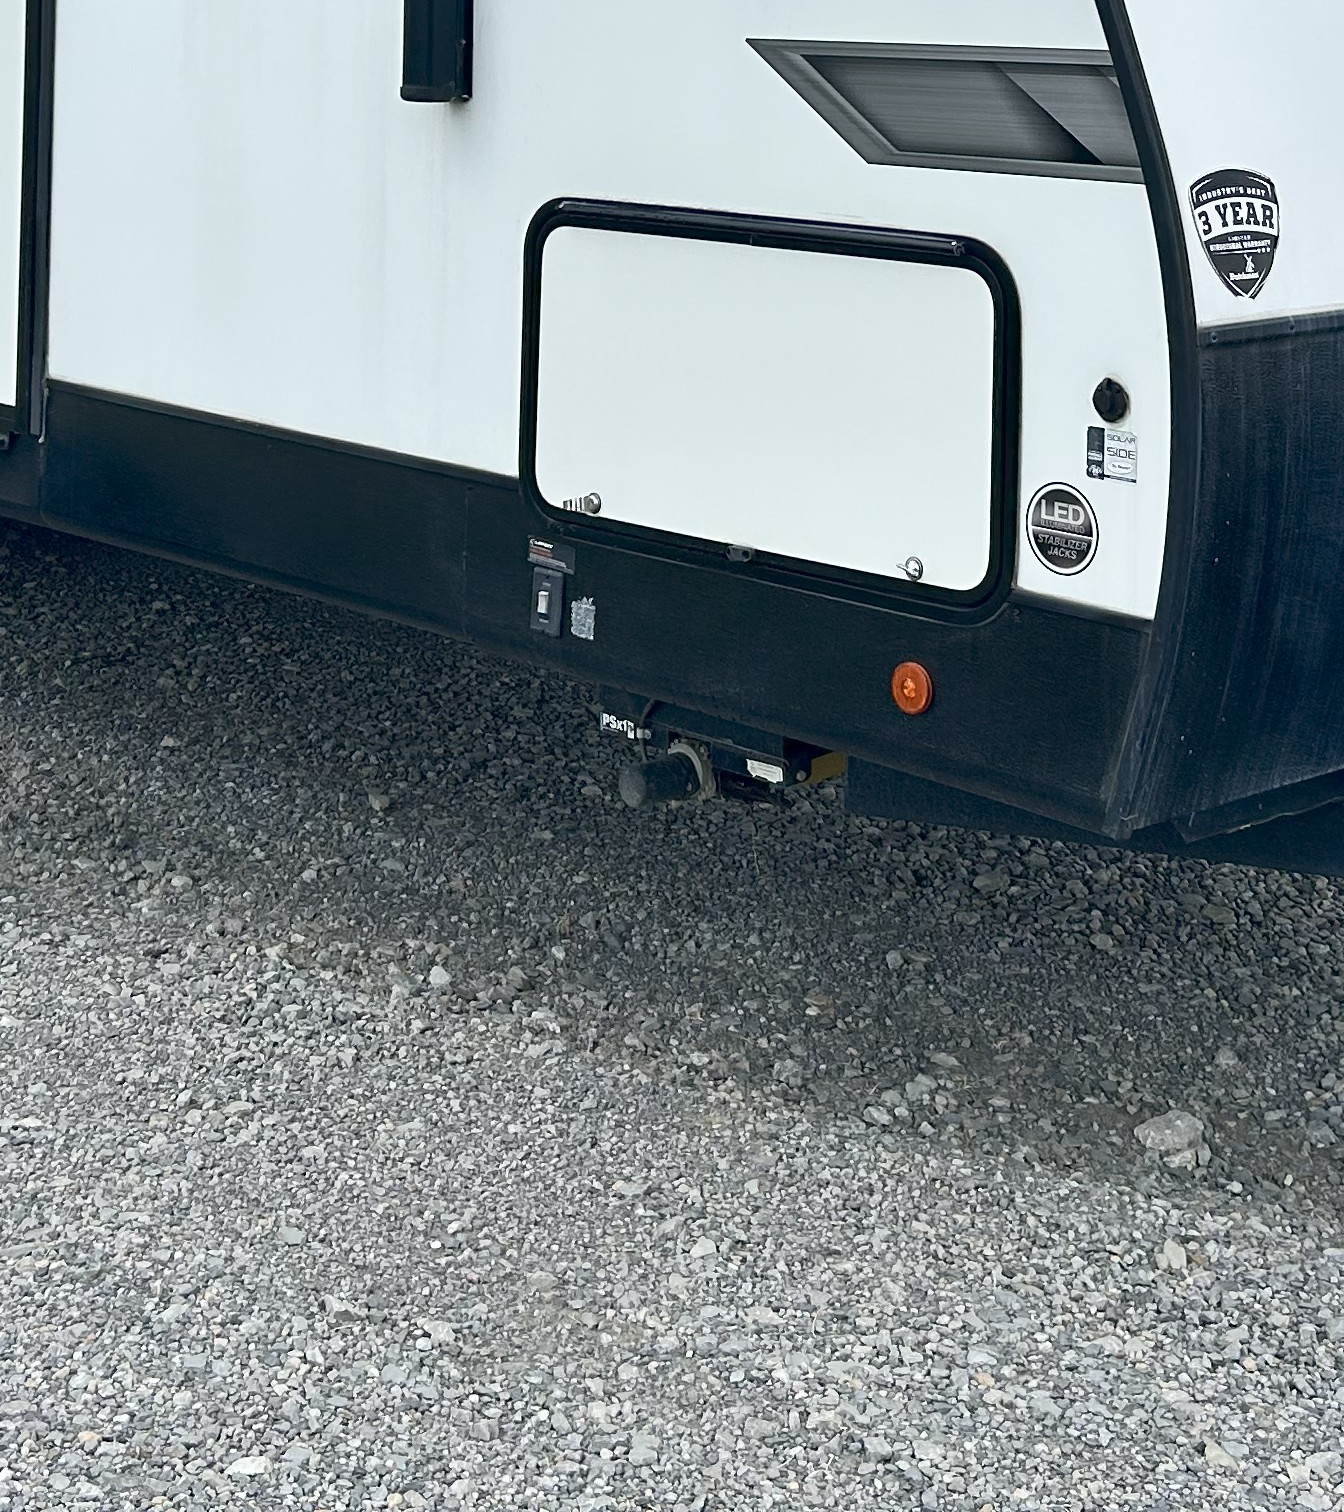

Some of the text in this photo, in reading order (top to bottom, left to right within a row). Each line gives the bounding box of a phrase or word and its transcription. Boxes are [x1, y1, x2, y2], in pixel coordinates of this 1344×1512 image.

[1197, 201, 1275, 236] 3 YEAR
[1106, 446, 1136, 461] SIDE
[1040, 498, 1085, 526] LED
[1037, 533, 1088, 552] STABILIZER
[1047, 546, 1078, 560] JACKS
